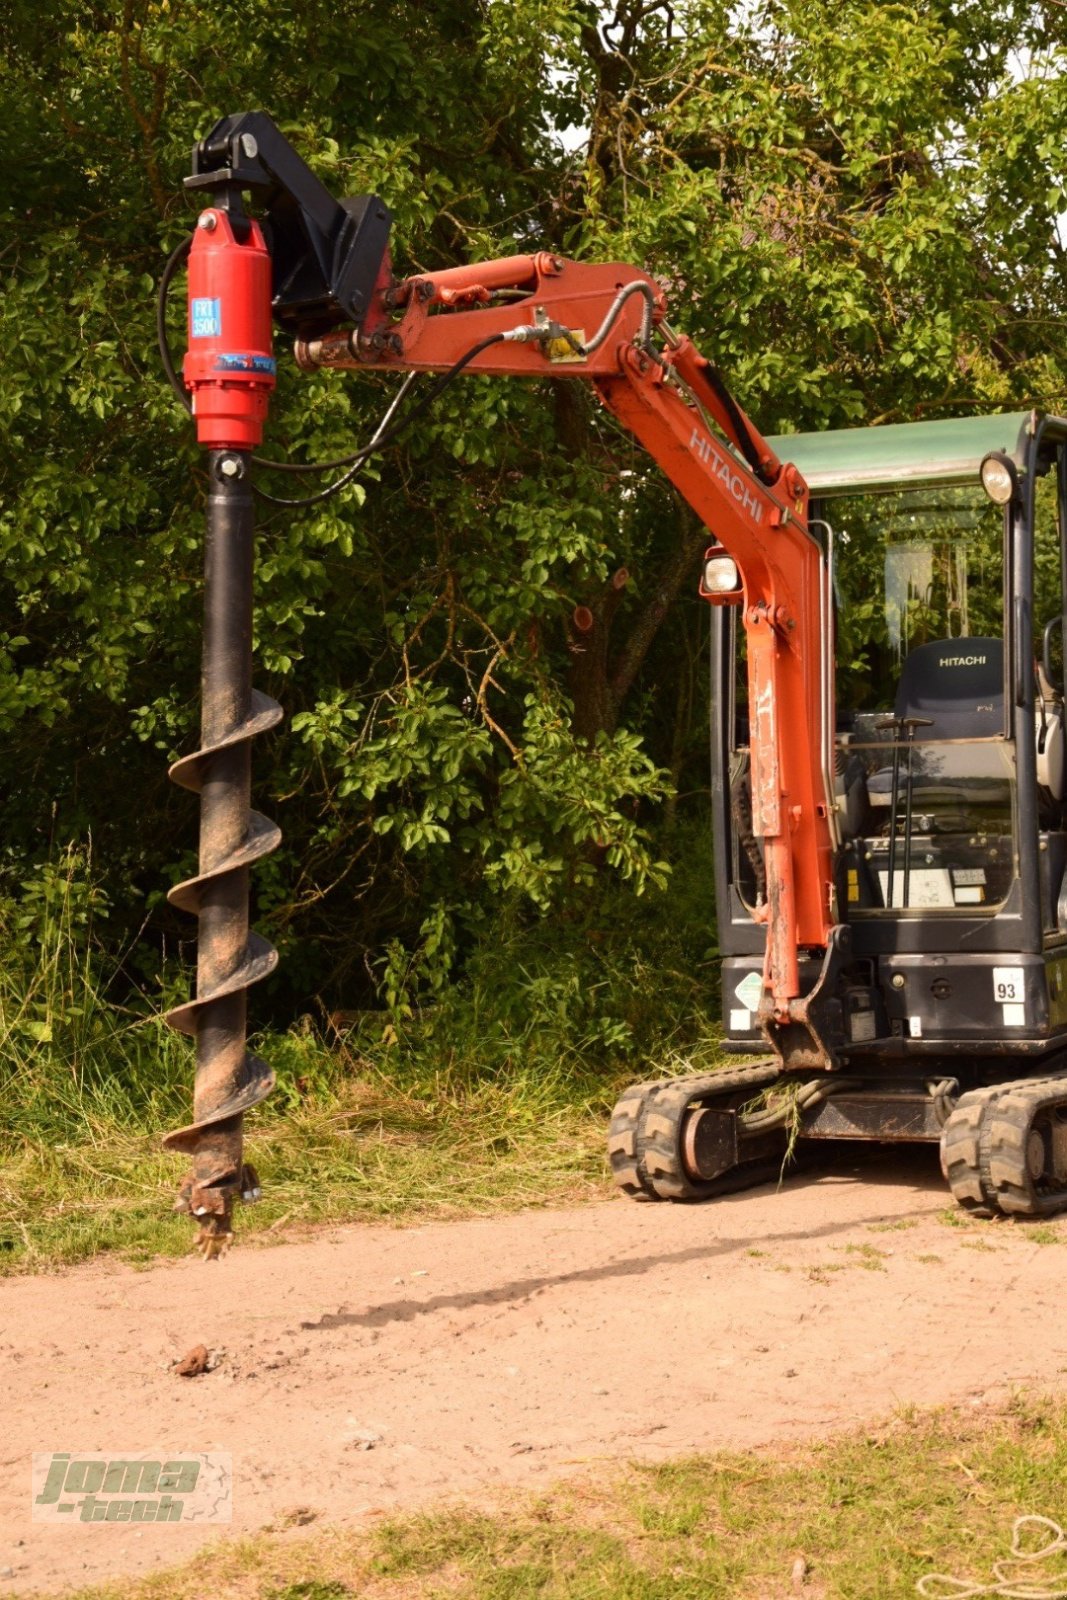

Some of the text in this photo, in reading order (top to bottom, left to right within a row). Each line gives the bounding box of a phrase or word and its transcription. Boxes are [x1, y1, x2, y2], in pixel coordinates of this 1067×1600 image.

[690, 428, 762, 523] HITACHI
[939, 655, 987, 667] HITACHI
[997, 983, 1016, 999] 93
